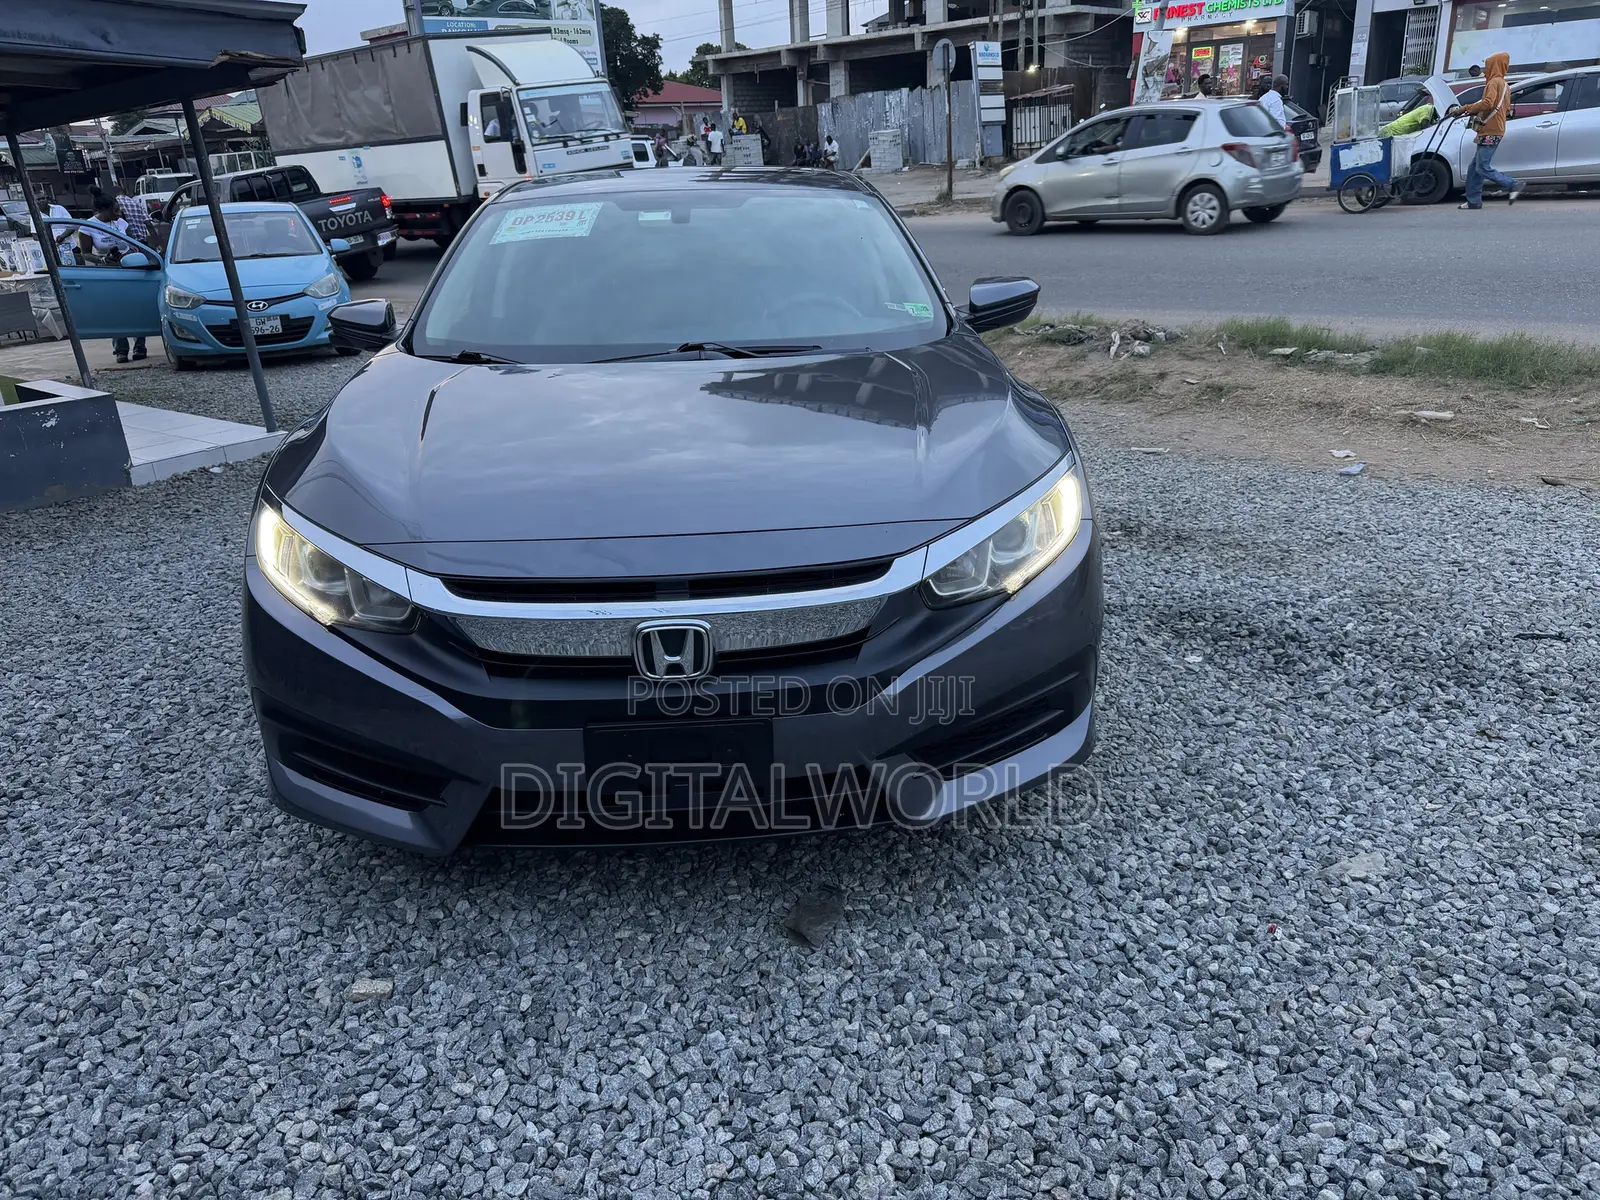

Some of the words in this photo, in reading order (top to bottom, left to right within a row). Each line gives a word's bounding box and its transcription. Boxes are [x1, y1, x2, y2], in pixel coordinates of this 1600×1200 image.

[1206, 0, 1260, 13] CHEMISTS
[1181, 11, 1233, 22] PHARMACY
[318, 210, 373, 232] TOYOTA
[255, 318, 266, 326] GW
